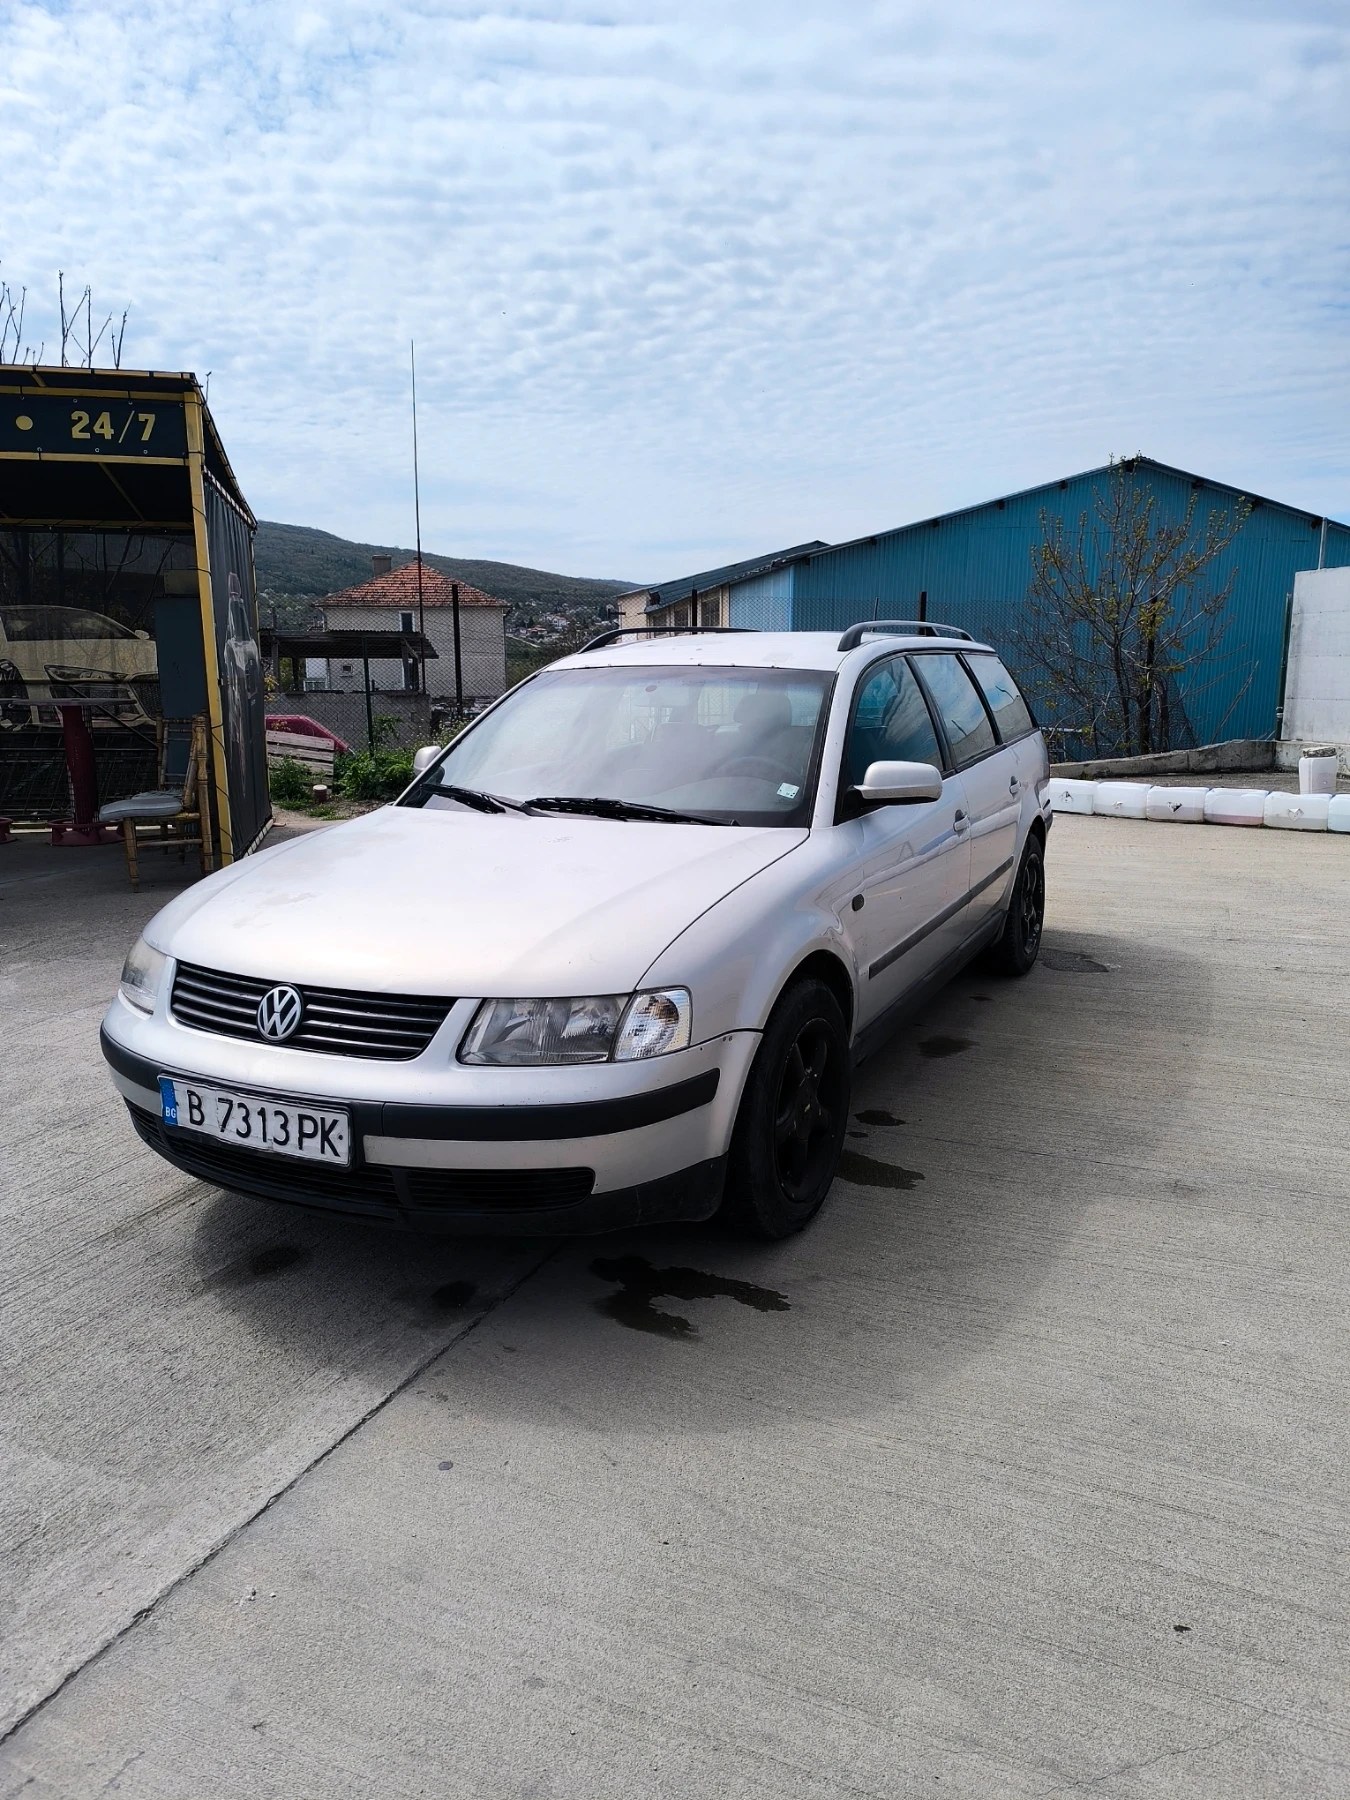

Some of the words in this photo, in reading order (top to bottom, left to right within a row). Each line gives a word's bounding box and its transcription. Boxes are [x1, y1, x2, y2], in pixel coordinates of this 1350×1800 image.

[71, 410, 156, 444] 24/7
[259, 987, 300, 1039] VW
[165, 1106, 177, 1119] BG
